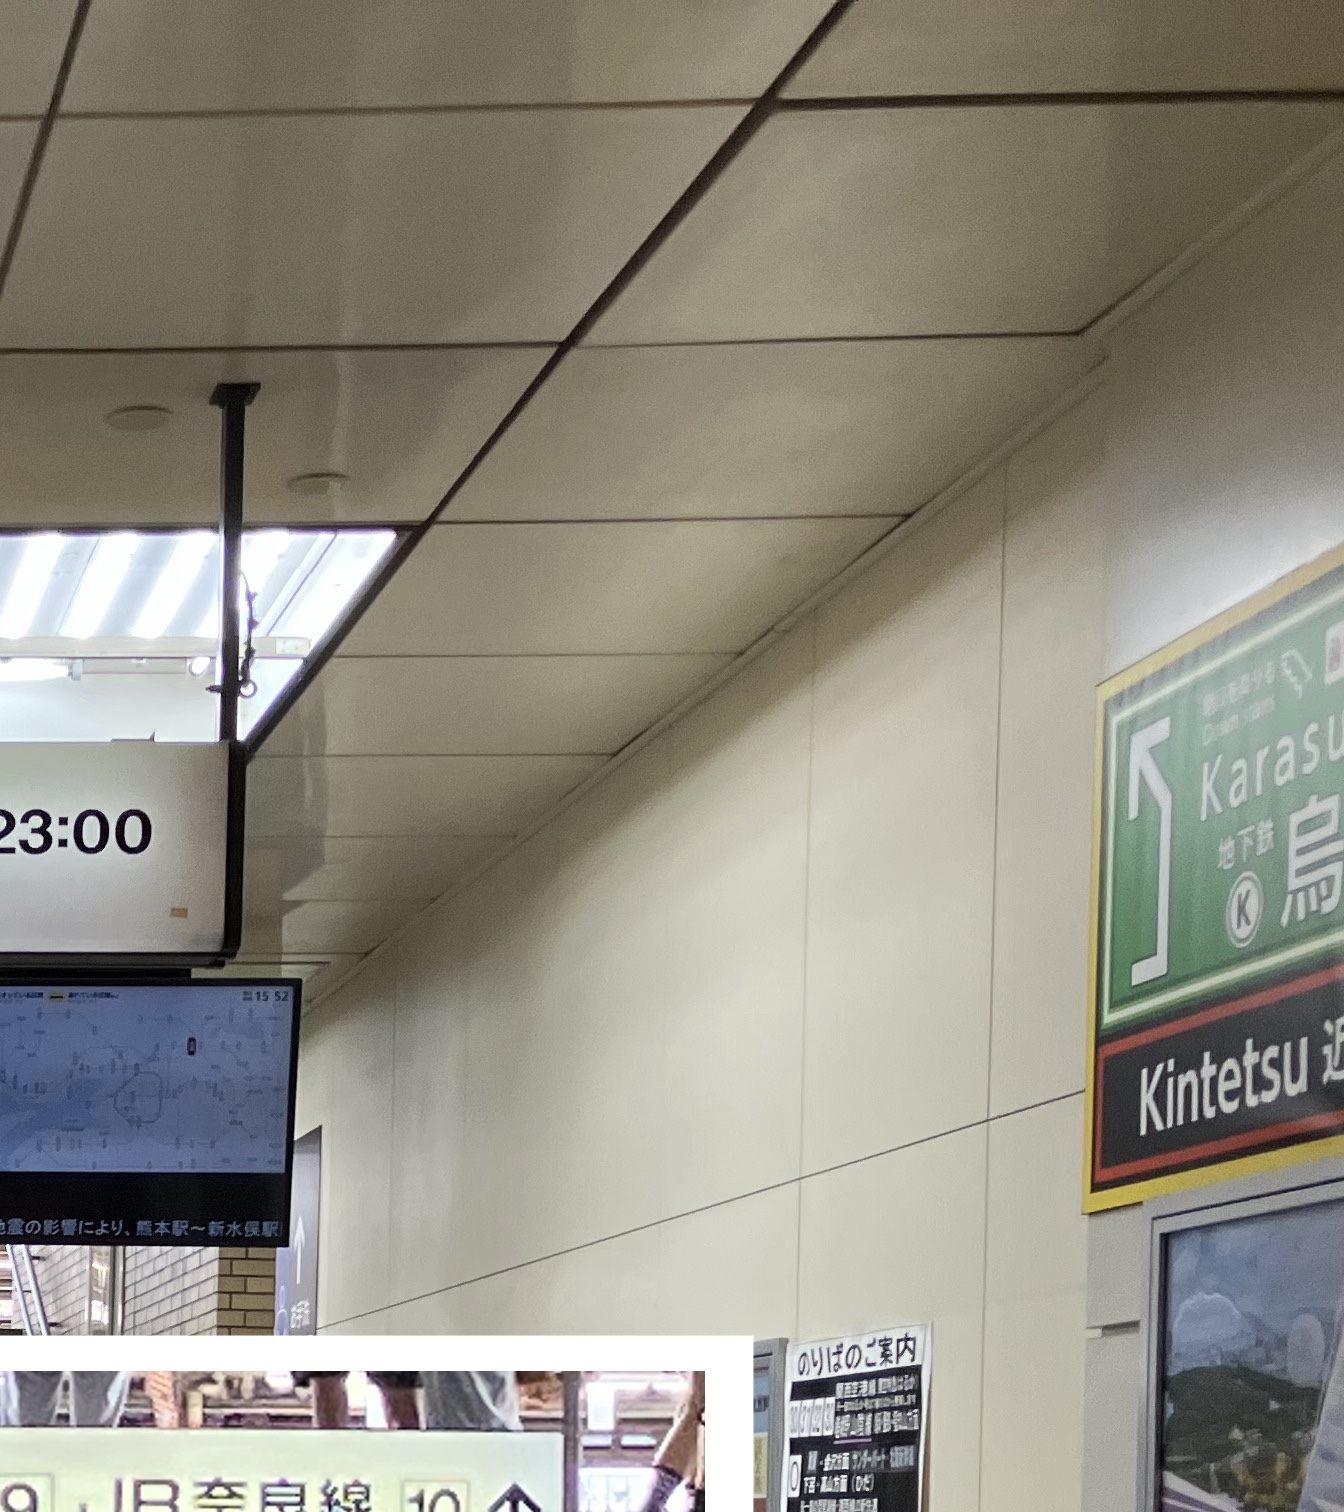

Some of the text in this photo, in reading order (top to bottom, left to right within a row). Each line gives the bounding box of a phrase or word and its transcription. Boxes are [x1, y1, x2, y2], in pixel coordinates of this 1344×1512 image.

[1217, 819, 1275, 871] 地下鉄
[1236, 889, 1251, 930] K
[1139, 1036, 1309, 1137] Kintetsu
[798, 1332, 917, 1377] のりばのご案内
